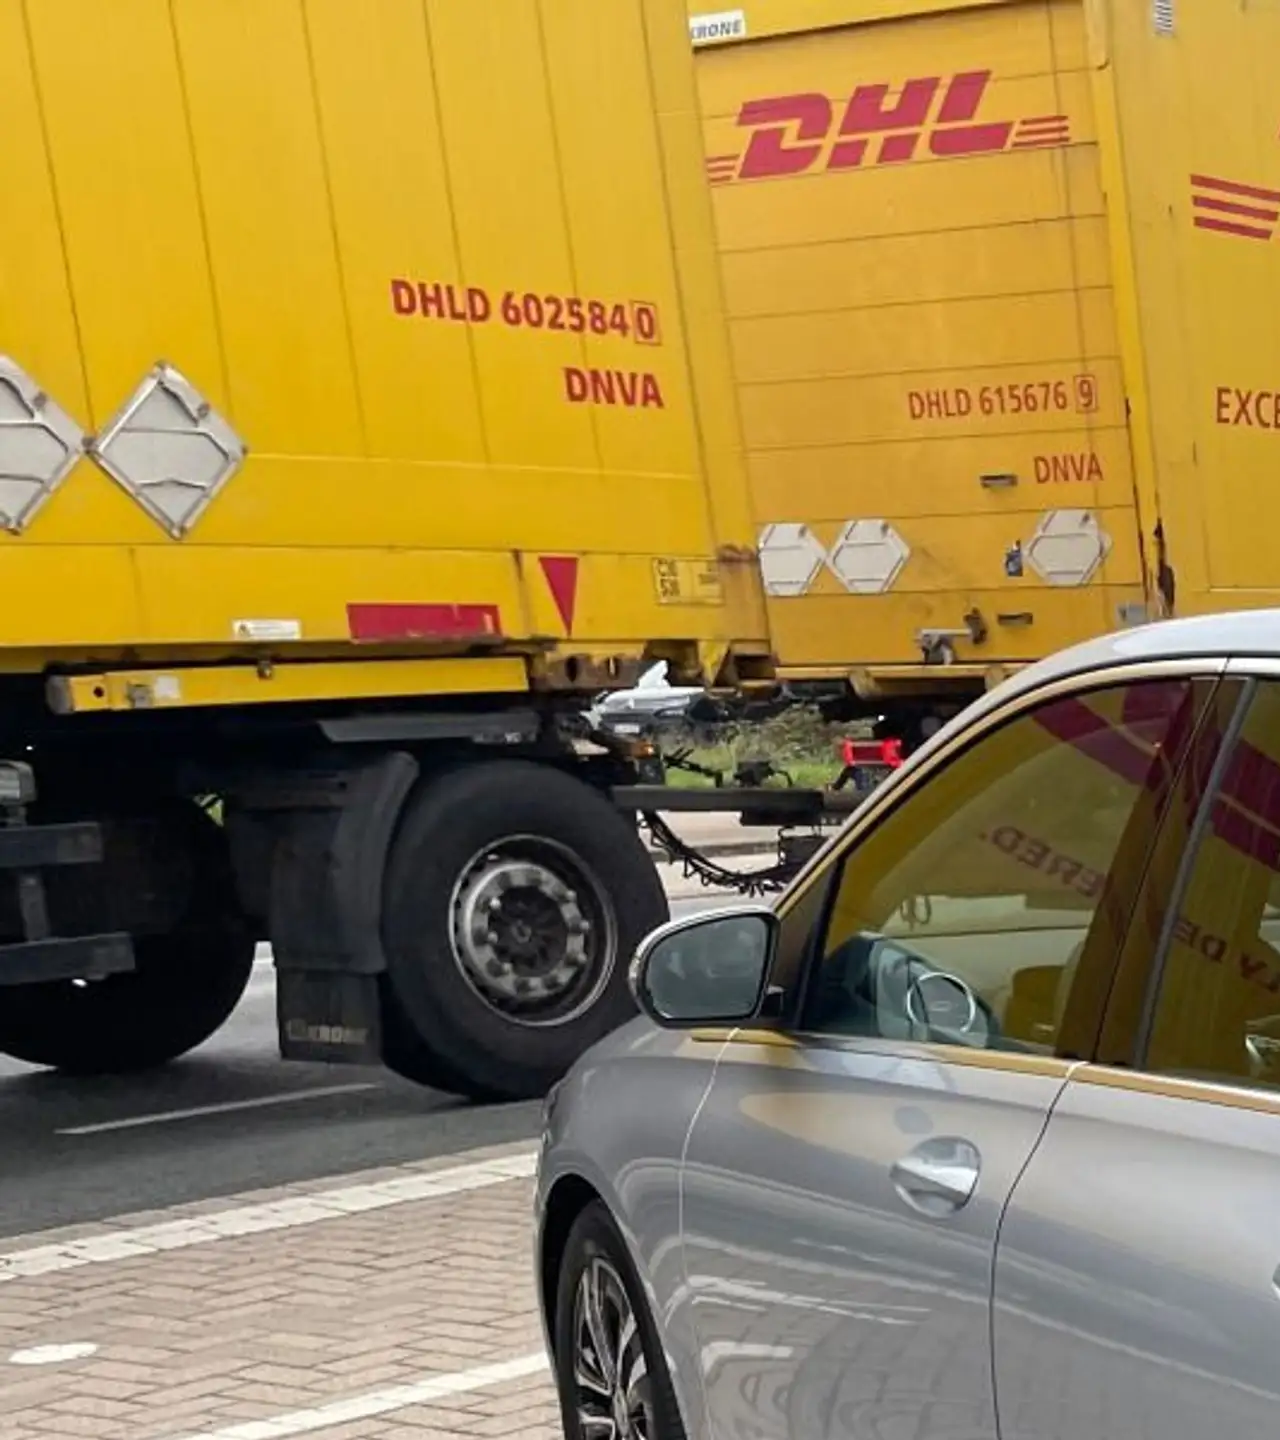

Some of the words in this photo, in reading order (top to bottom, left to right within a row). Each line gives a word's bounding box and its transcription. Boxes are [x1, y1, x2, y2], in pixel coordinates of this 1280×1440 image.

[736, 69, 1014, 180] DHL
[391, 279, 490, 324] DHLD
[563, 366, 665, 409] DNVA
[908, 388, 972, 420] DHLD
[979, 381, 1068, 416] 615676
[1033, 452, 1104, 485] DNVA
